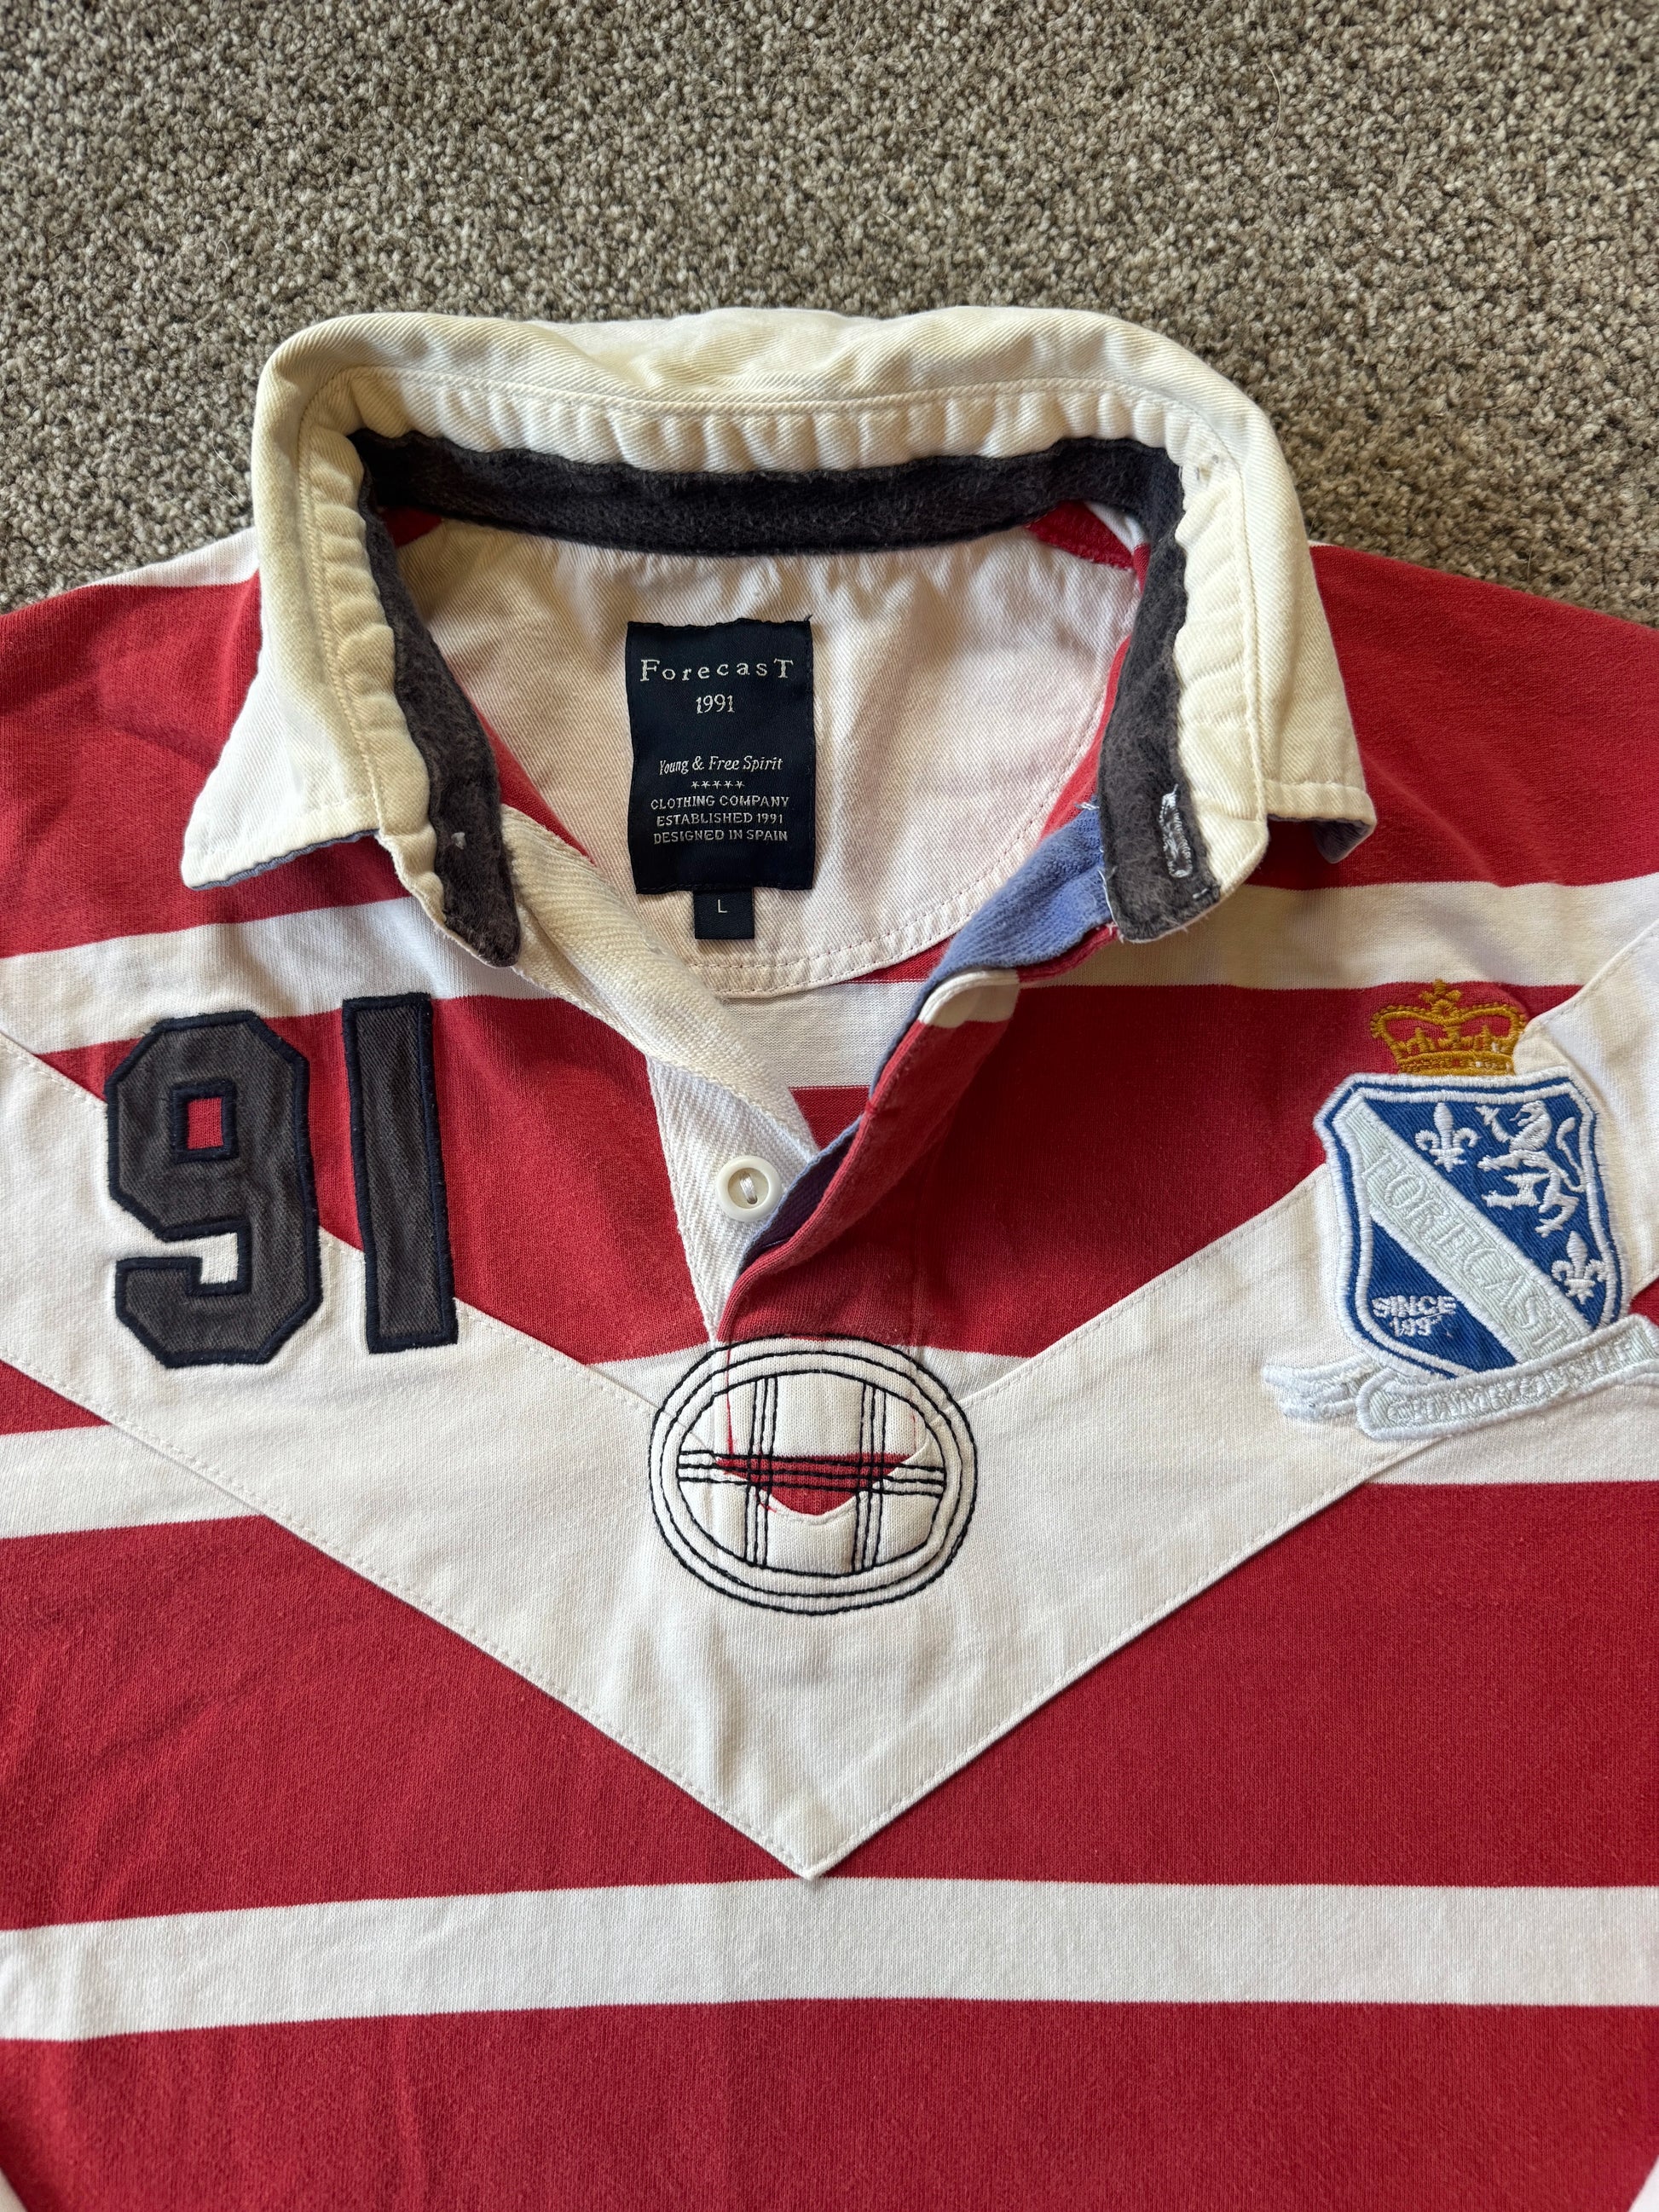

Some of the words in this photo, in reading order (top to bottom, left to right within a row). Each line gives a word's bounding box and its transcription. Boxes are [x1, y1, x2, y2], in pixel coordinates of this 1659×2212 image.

[639, 657, 794, 683] ForecasT
[695, 693, 736, 715] 1991
[659, 759, 690, 777] Young
[691, 755, 705, 771] &
[708, 755, 740, 771] Free
[743, 754, 783, 774] Spirit
[650, 795, 715, 811] CLOTHING
[719, 794, 790, 808] COMPANY
[656, 811, 753, 828] ESTABLISHED
[755, 812, 783, 825] 1991
[653, 829, 725, 846] DESIGNED
[728, 829, 743, 841] IN
[746, 829, 789, 843] SPAIN
[716, 898, 729, 914] L
[103, 990, 460, 1370] 91
[1361, 1147, 1577, 1352] FORECAST
[1371, 1294, 1457, 1318] SINCE
